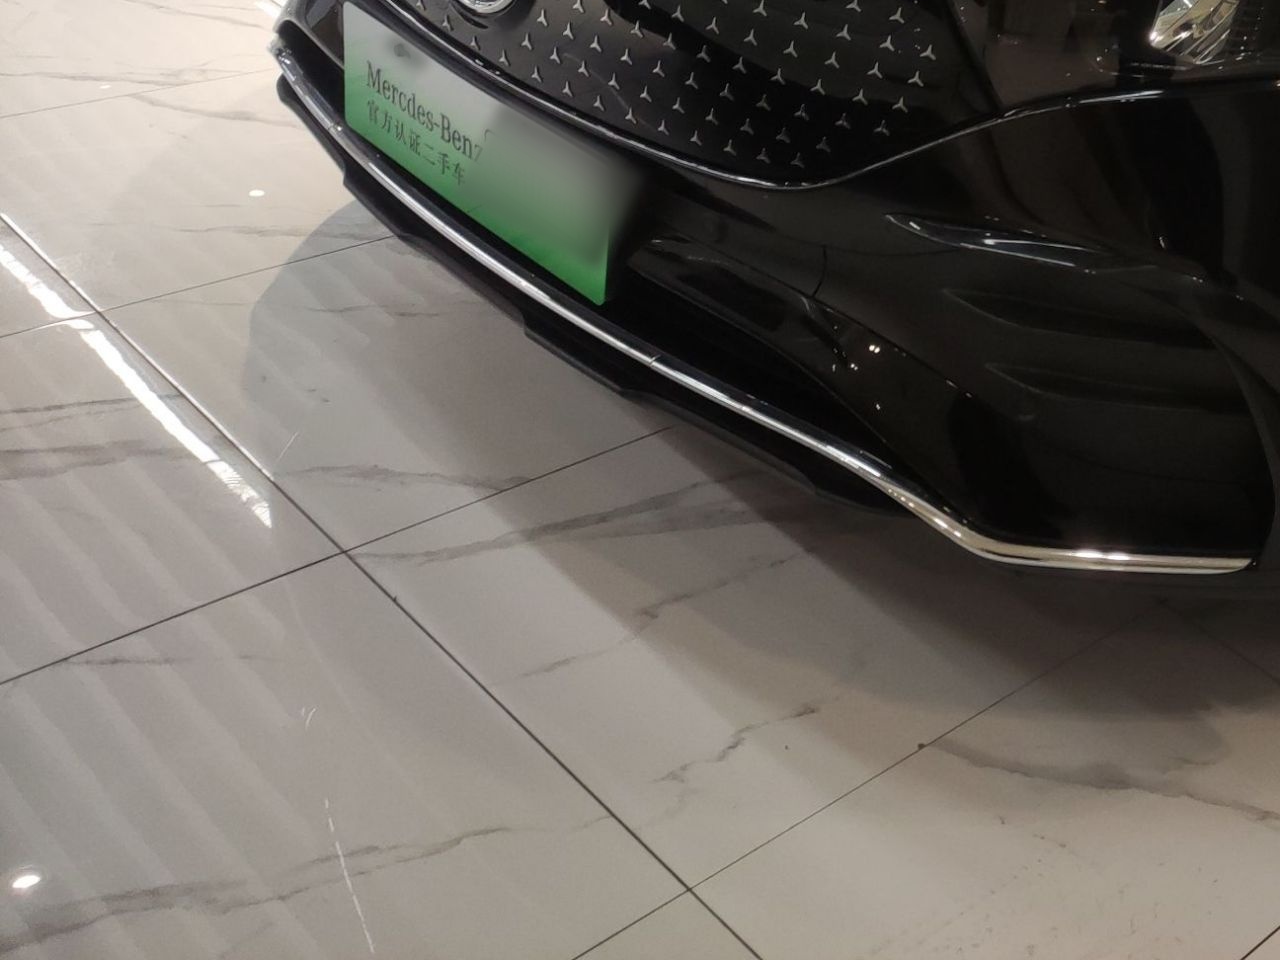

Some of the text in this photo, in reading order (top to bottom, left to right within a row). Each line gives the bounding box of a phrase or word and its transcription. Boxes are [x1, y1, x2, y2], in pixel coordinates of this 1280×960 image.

[367, 100, 465, 185] 官方认证二手车
